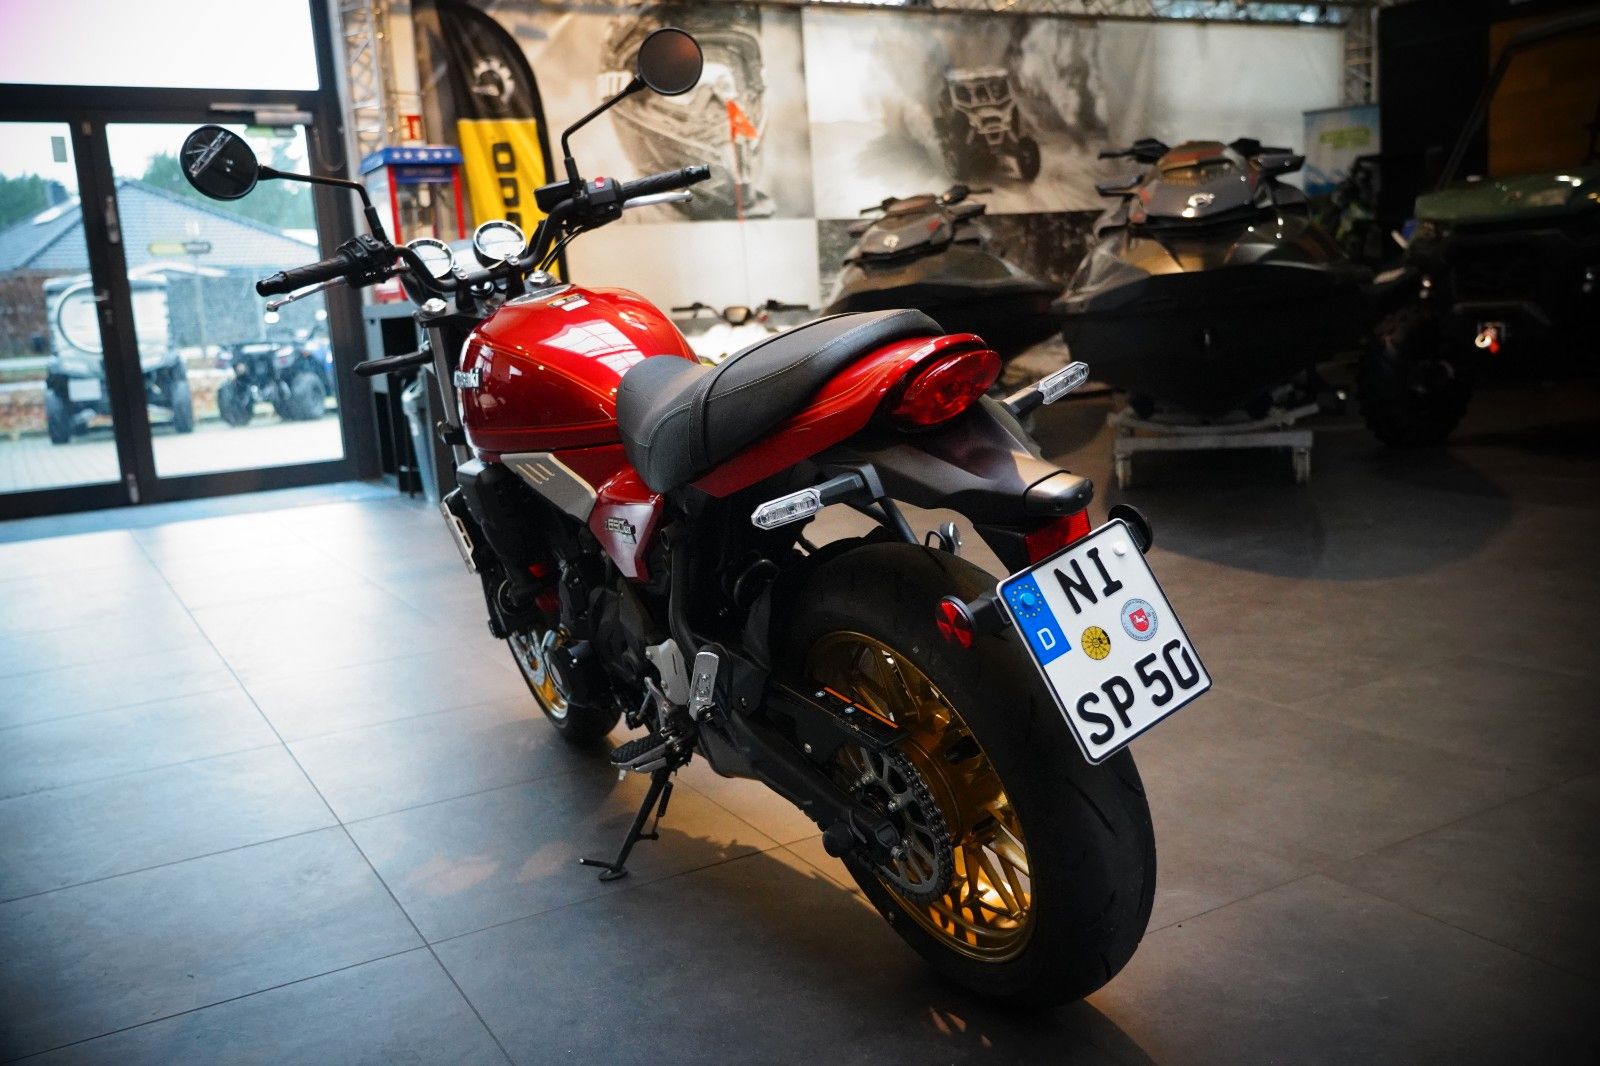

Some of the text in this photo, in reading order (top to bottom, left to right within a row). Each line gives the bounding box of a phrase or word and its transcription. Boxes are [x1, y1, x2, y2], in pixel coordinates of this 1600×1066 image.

[1053, 547, 1123, 614] NI
[1036, 627, 1056, 650] D
[1076, 675, 1135, 745] SP
[1134, 639, 1200, 706] 50
